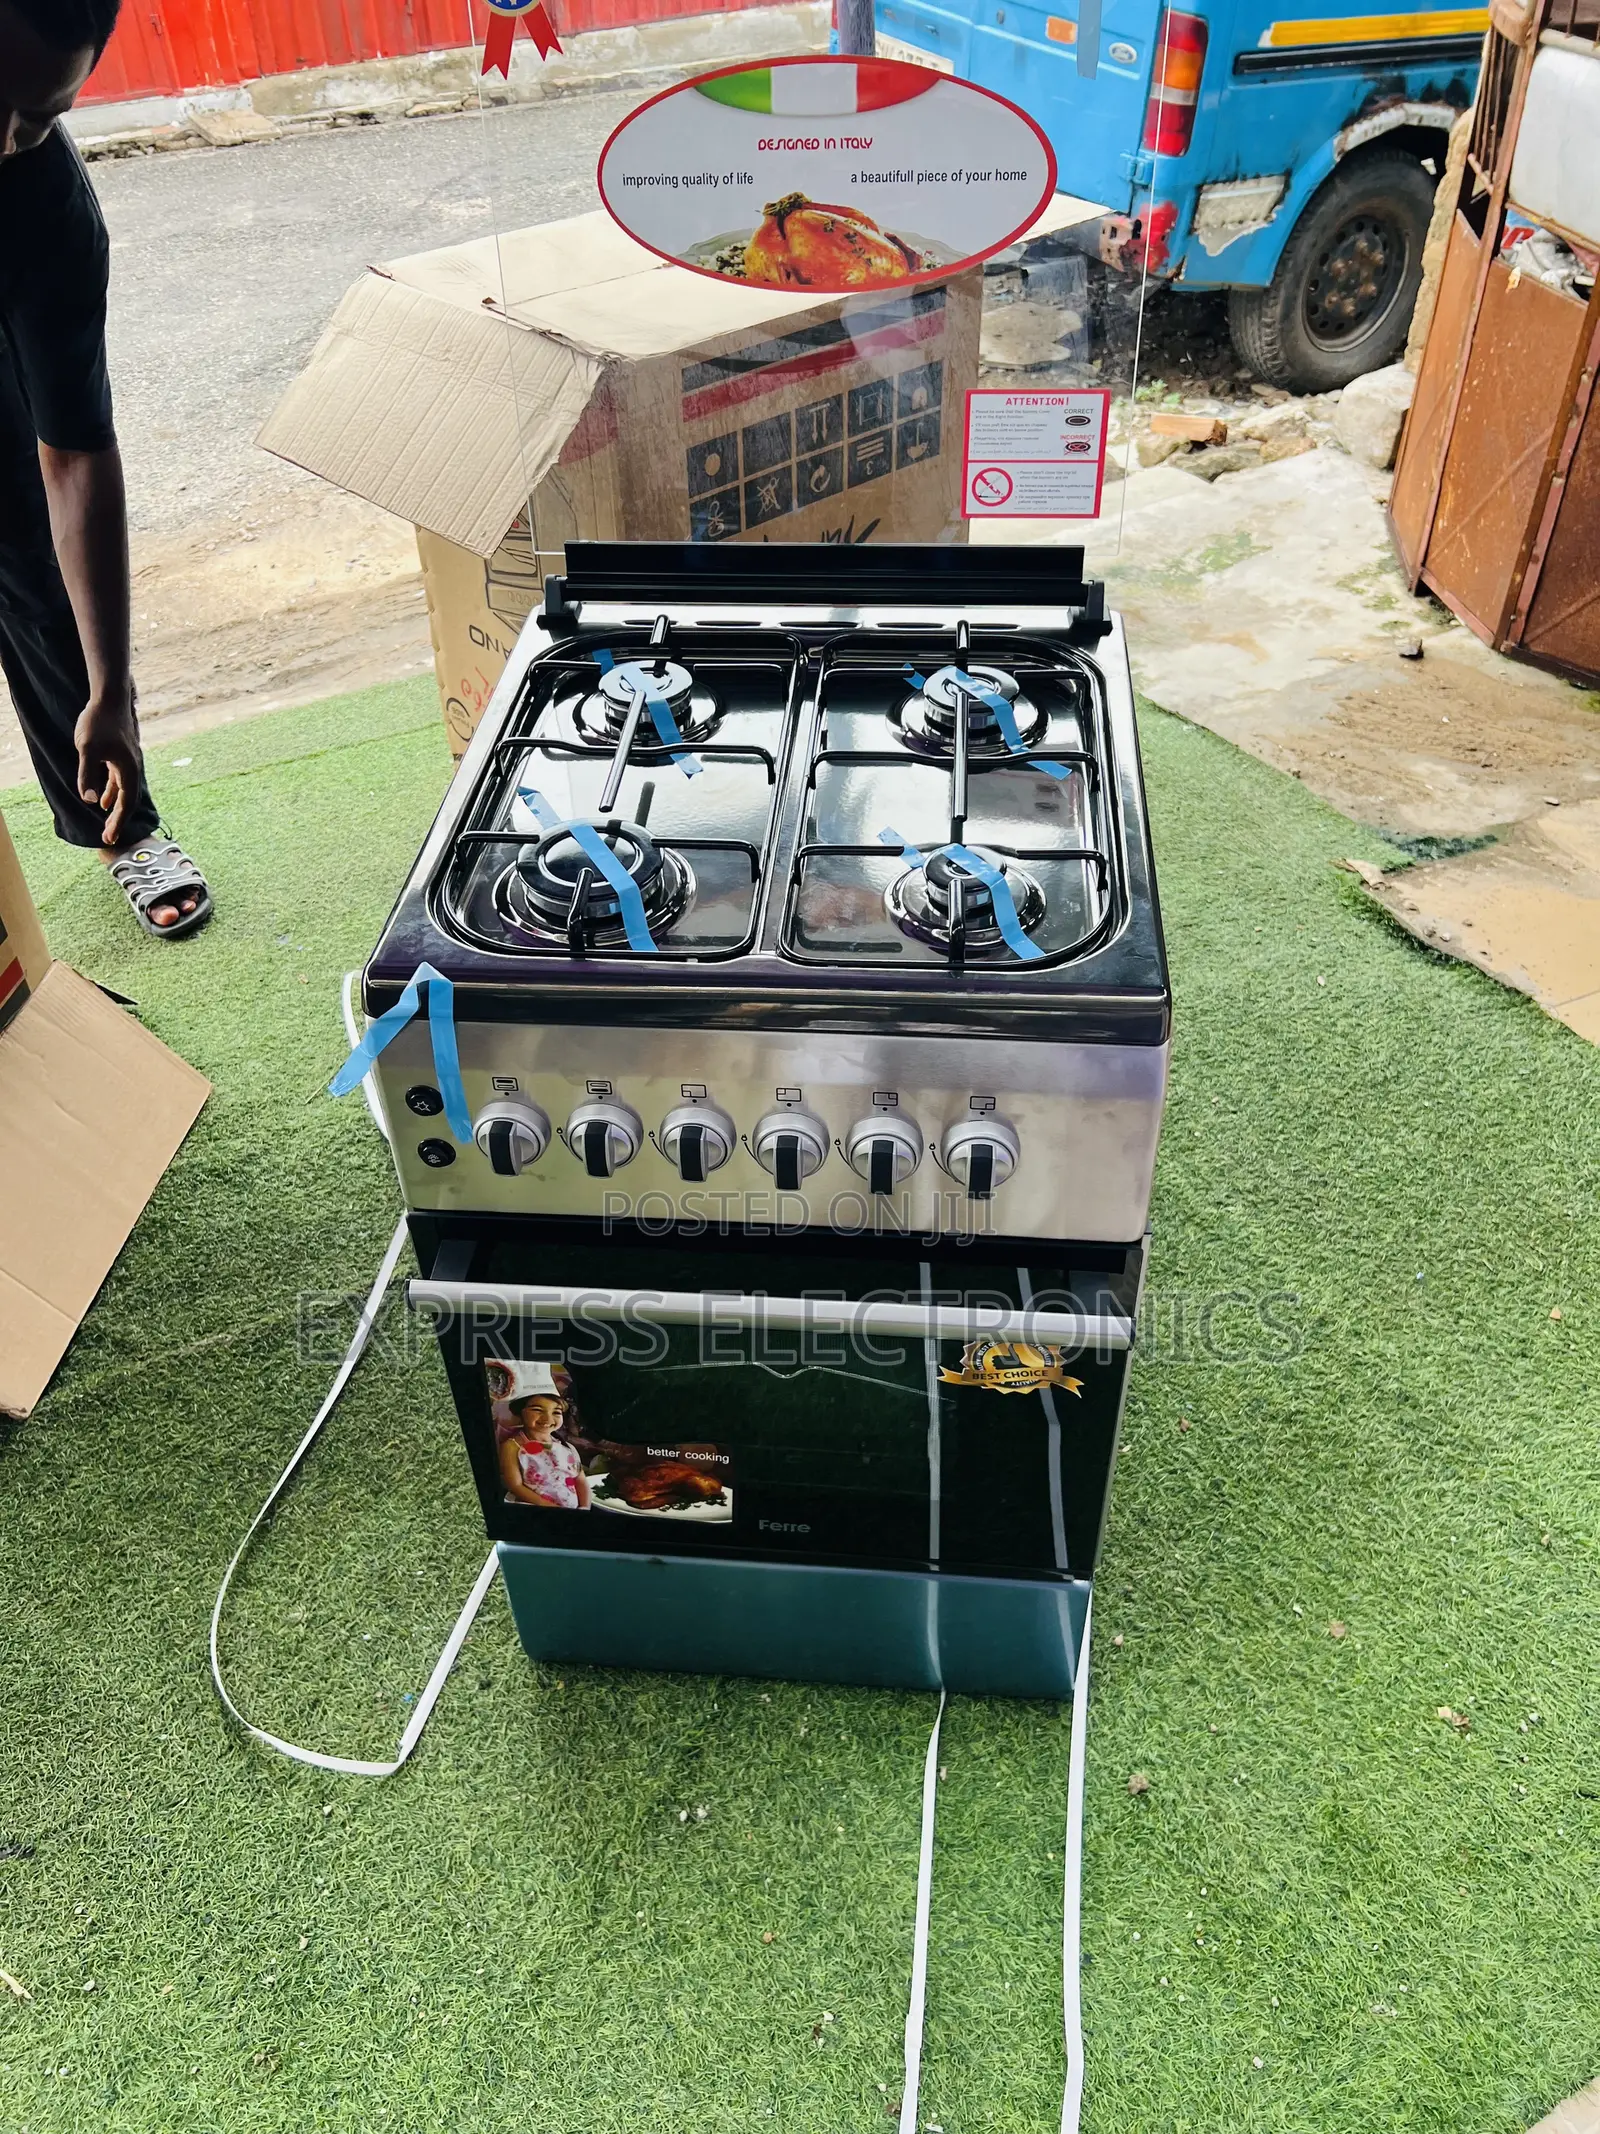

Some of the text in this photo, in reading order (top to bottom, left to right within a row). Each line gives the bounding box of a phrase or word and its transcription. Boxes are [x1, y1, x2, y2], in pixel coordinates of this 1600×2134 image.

[758, 137, 873, 151] DESIGNED IN ITALY
[622, 171, 754, 188] improving quality of life
[850, 168, 1027, 185] a beautifull piece of your home
[1005, 397, 1070, 406] ATTENTION!
[972, 1369, 1048, 1380] BEST CHOICE
[646, 1446, 730, 1465] better cooking
[758, 1519, 811, 1533] Ferre
